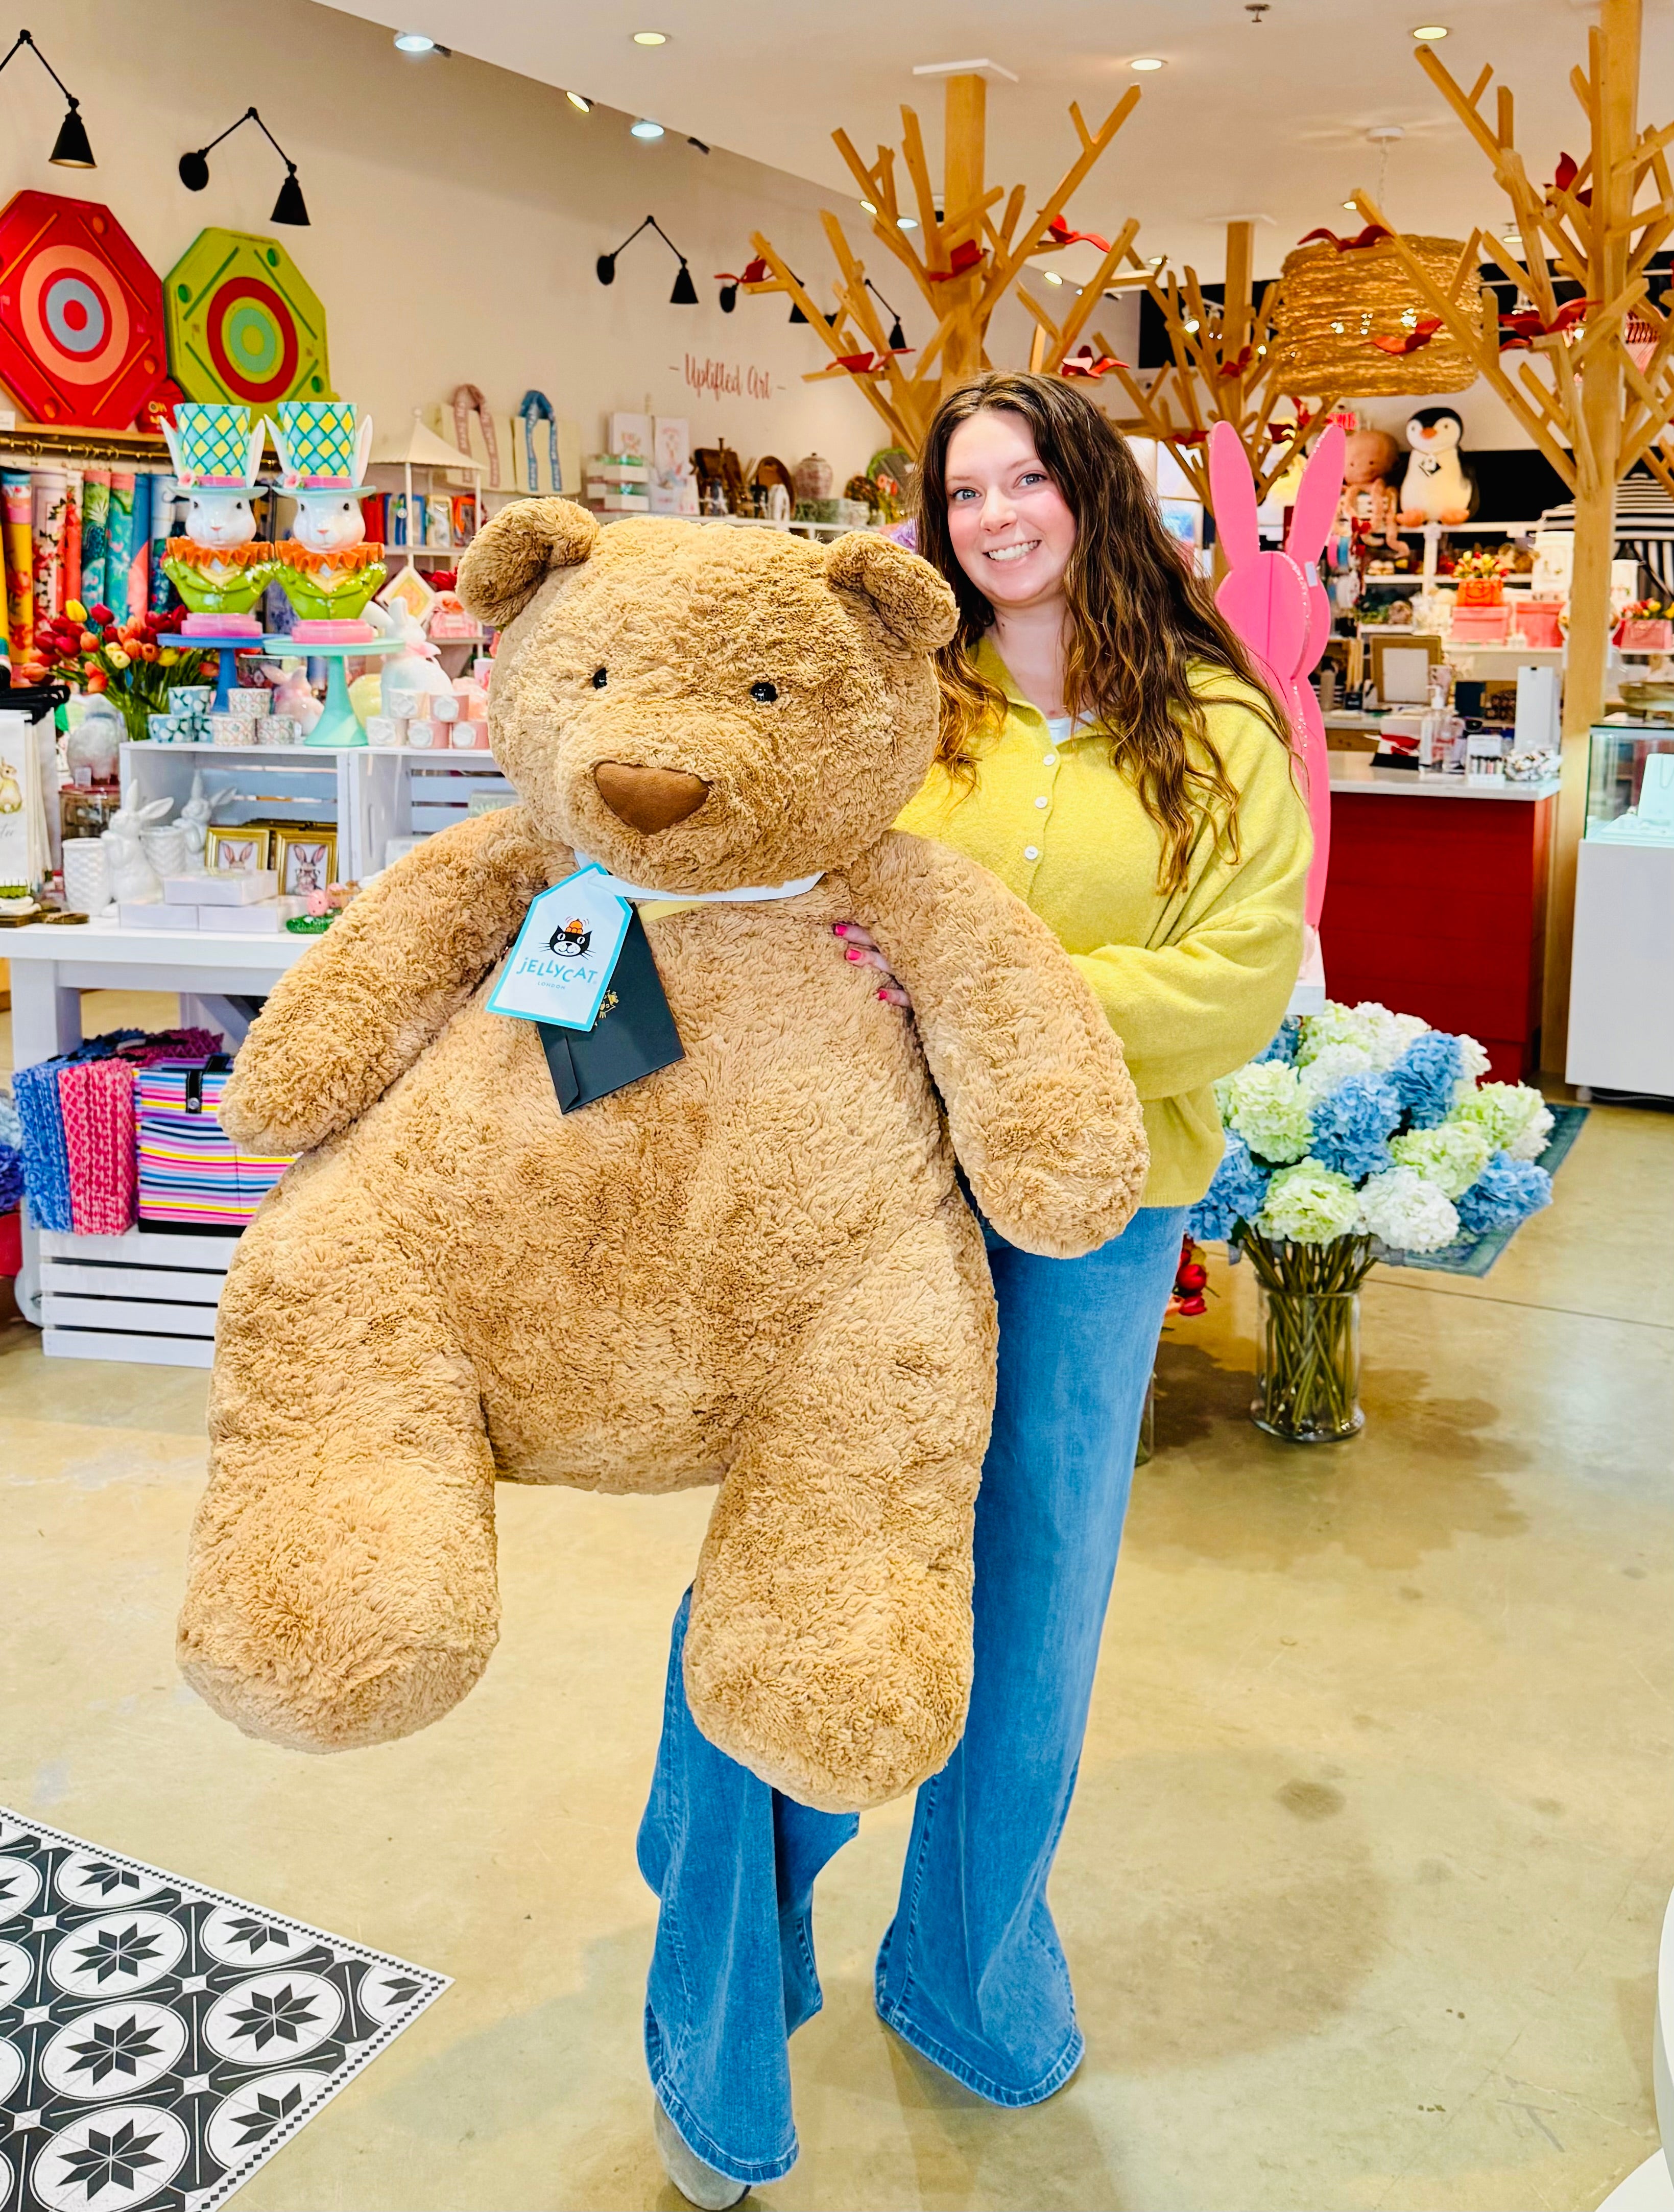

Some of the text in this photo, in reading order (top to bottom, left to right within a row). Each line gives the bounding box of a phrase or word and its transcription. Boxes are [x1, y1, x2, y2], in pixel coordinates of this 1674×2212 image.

[685, 353, 770, 401] Uplifted Art
[538, 981, 566, 990] LONDON
